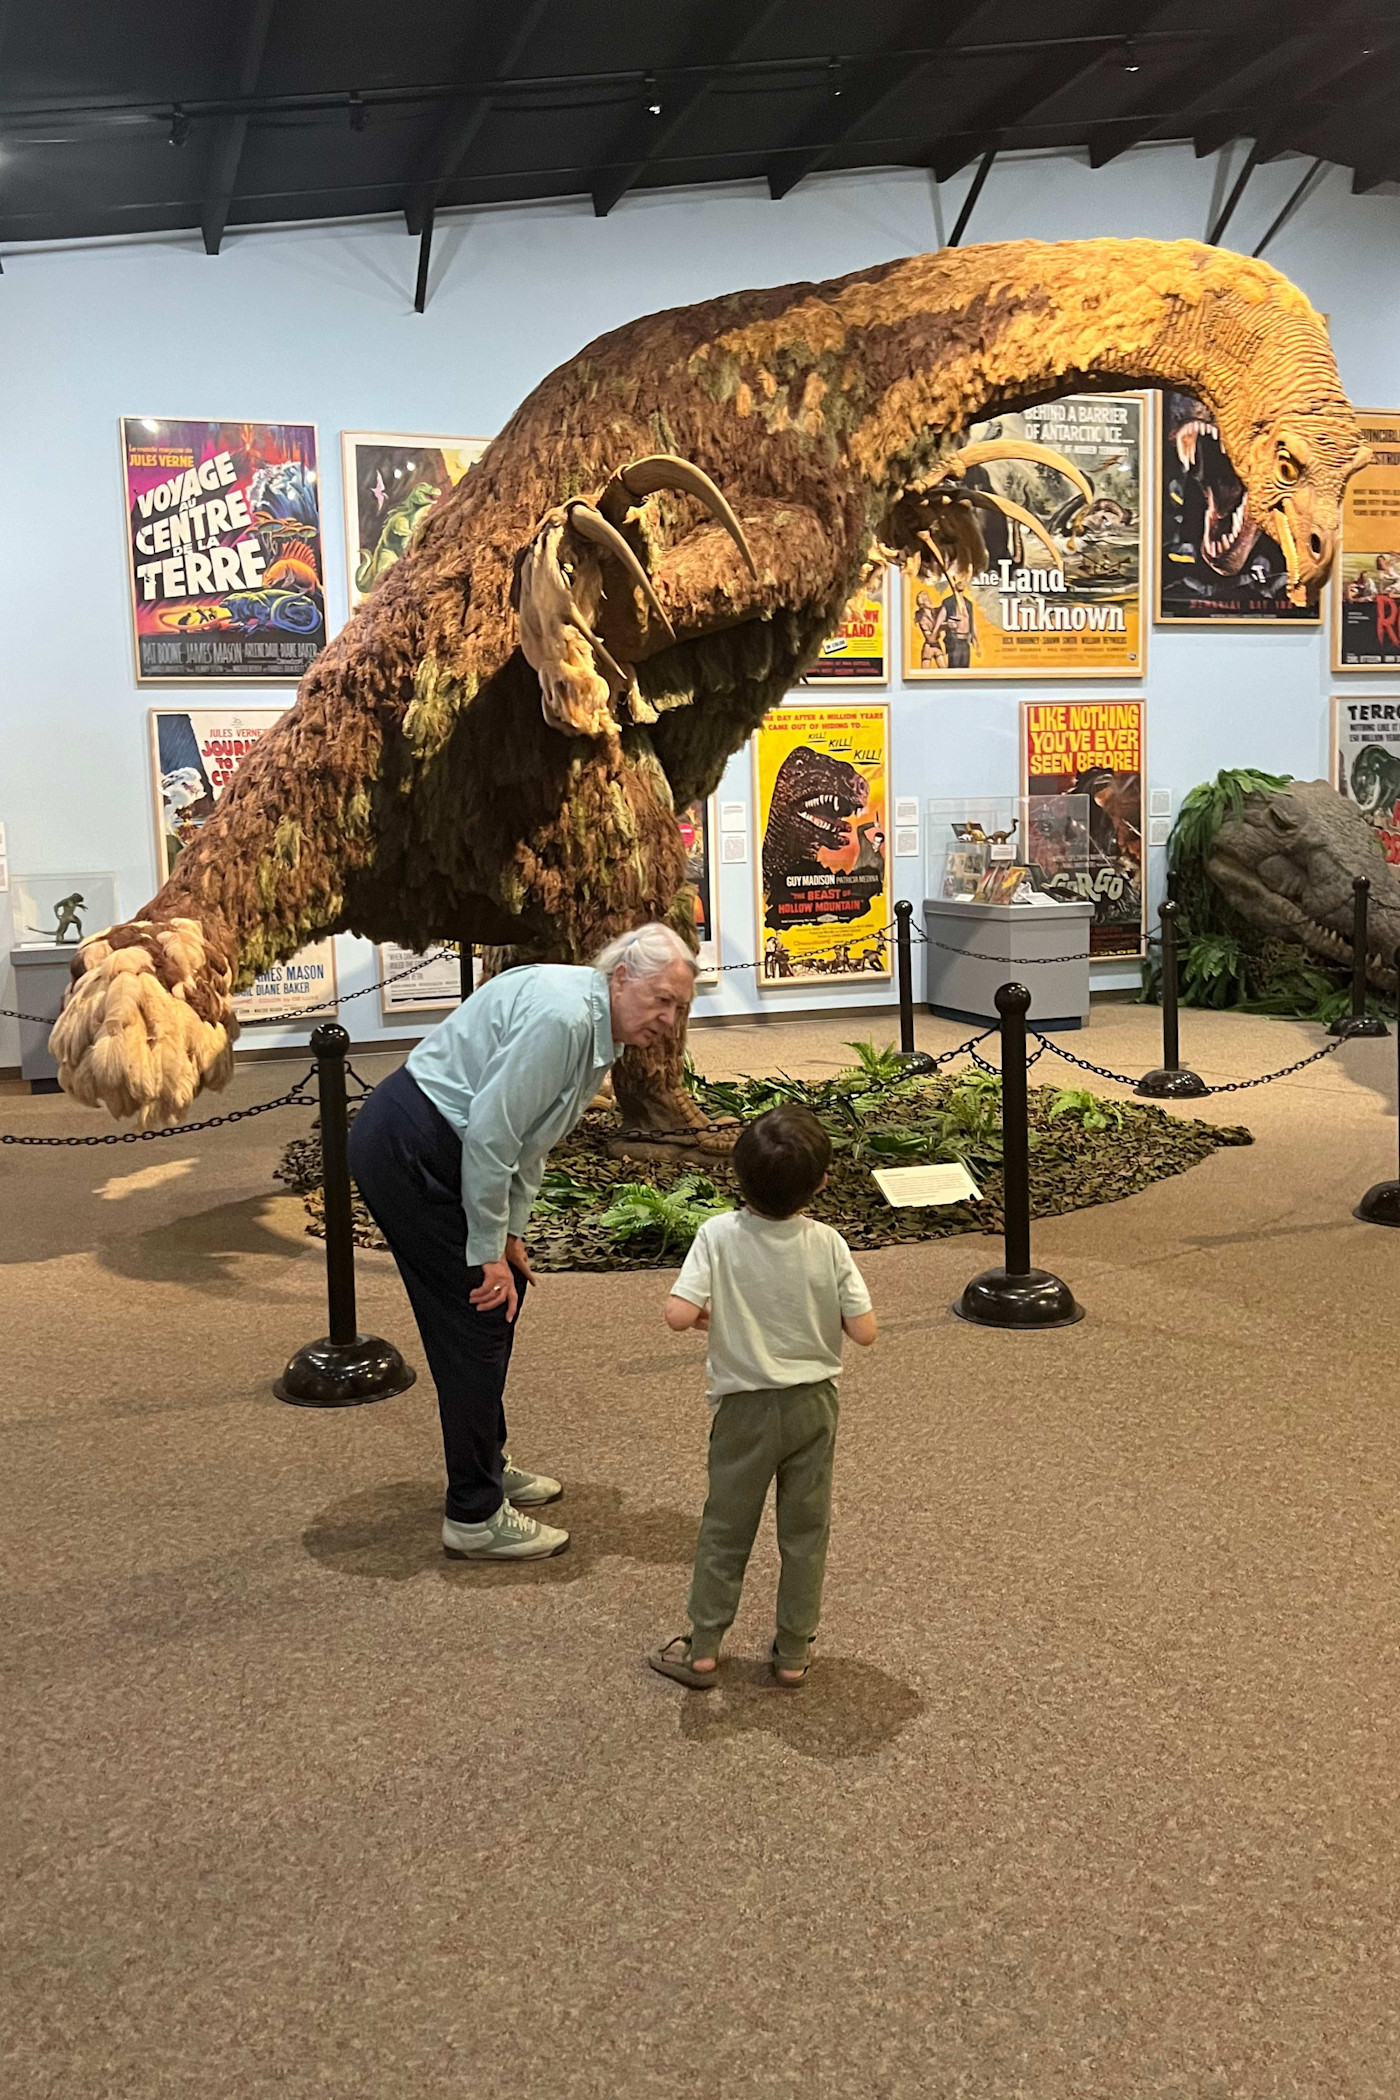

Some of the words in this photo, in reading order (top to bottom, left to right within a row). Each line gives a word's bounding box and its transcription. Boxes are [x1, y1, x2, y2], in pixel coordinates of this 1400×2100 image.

[1024, 404, 1066, 421] BEHIND
[1067, 405, 1077, 422] A
[1079, 406, 1128, 424] BARRIER
[1025, 423, 1040, 440] OF
[1041, 424, 1102, 442] ANTARCTIC
[129, 454, 157, 467] JULES
[158, 455, 194, 468] VERNE
[137, 451, 238, 518] VOYAGE
[179, 498, 196, 513] AU
[136, 490, 252, 556] CENTRE
[172, 542, 193, 557] DE
[197, 535, 220, 551] LA
[136, 539, 266, 601] TERRE
[972, 571, 999, 586] he
[998, 559, 1068, 594] Land
[999, 598, 1127, 632] Unknown
[838, 624, 876, 639] SLAND
[827, 713, 857, 721] MILLION
[860, 712, 884, 720] YEARS
[1030, 706, 1067, 732] LIKE
[1069, 705, 1139, 730] NOTHING
[210, 729, 233, 738] JULES
[822, 722, 848, 730] HIDING
[202, 739, 256, 758] JOURN
[828, 736, 853, 748] KILL!
[1030, 730, 1091, 754] YOU'VE
[1094, 729, 1139, 751] EVER
[853, 748, 882, 761] KILL!
[215, 757, 233, 769] TO
[1030, 752, 1073, 775] SEEN
[1077, 750, 1139, 773] BEFORE!
[786, 876, 802, 887] GUY
[802, 875, 836, 887] MADISON
[807, 889, 842, 900] BEAST
[778, 903, 813, 914] HOLLOW
[286, 965, 324, 981] MASON
[256, 983, 281, 996] DIANE
[283, 982, 310, 995] BAKER
